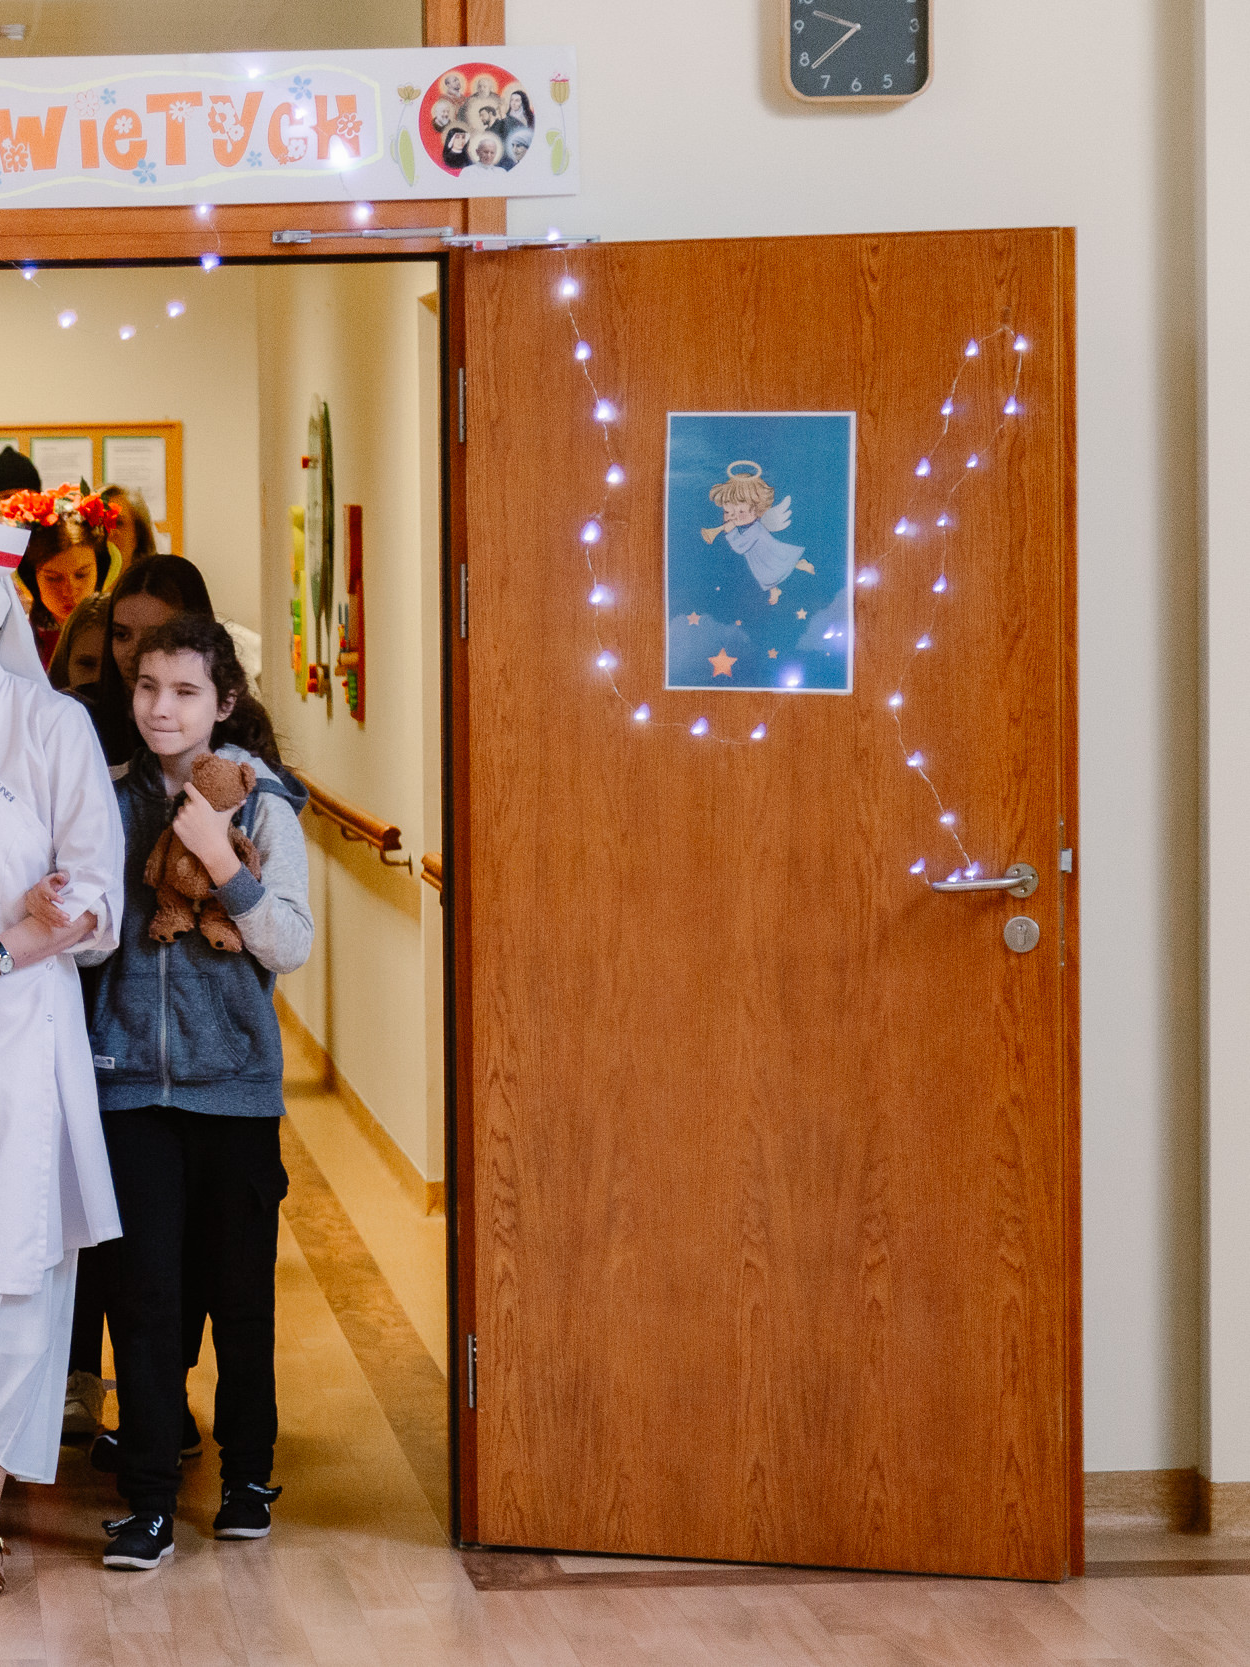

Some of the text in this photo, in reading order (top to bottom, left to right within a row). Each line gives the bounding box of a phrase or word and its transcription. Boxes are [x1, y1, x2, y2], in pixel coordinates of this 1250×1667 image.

[793, 19, 805, 34] 9
[909, 18, 920, 33] 3
[799, 51, 810, 67] 8
[906, 51, 917, 65] 4
[820, 74, 831, 89] 7
[851, 78, 862, 92] 6
[882, 74, 893, 89] 5
